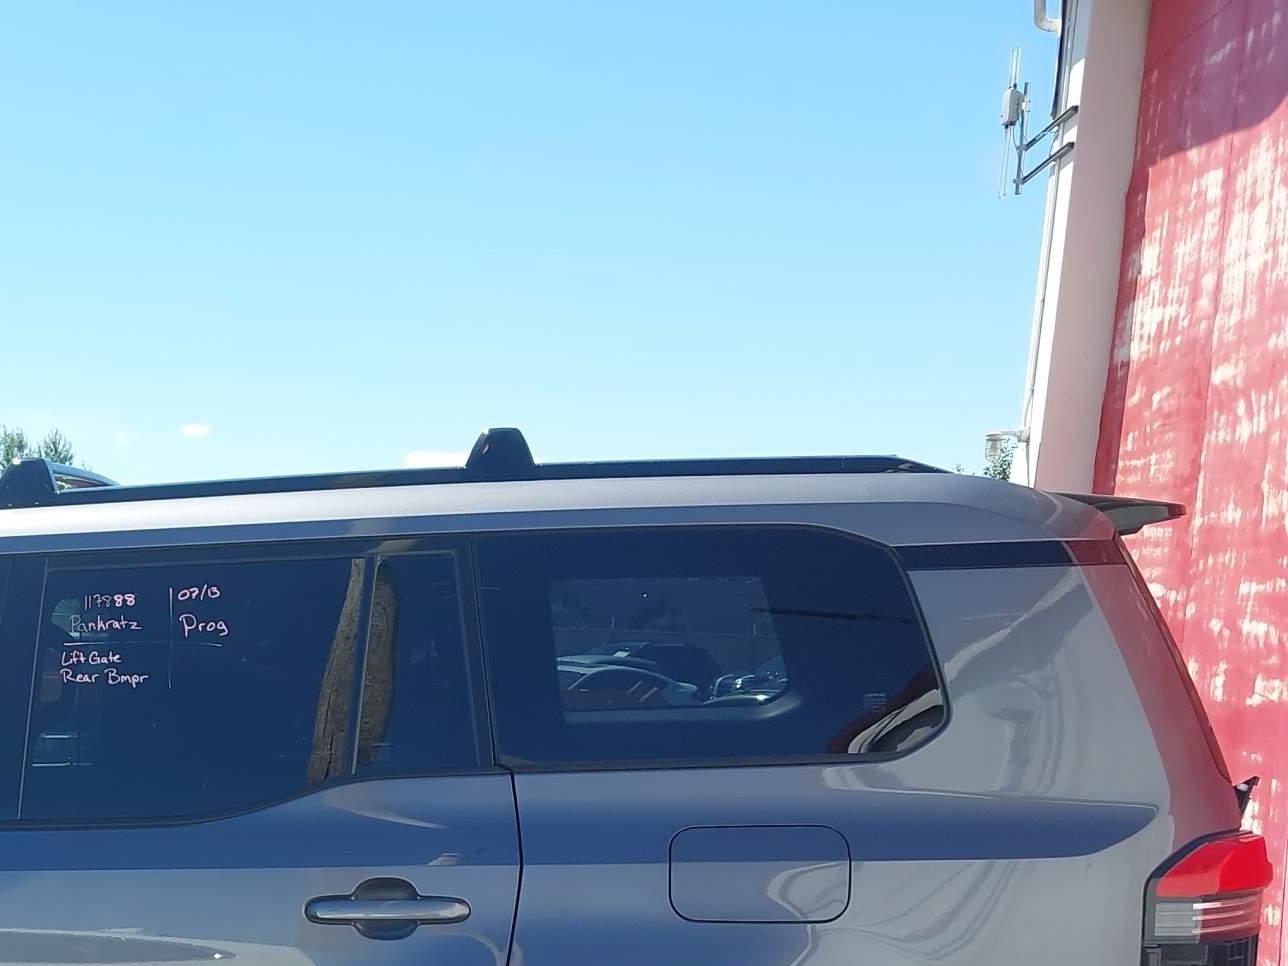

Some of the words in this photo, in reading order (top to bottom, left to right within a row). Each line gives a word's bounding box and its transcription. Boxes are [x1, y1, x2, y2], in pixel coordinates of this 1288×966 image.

[69, 614, 143, 633] Pankratz
[178, 613, 229, 639] Prog
[60, 668, 99, 684] Rear
[103, 668, 150, 688] Bmpr
